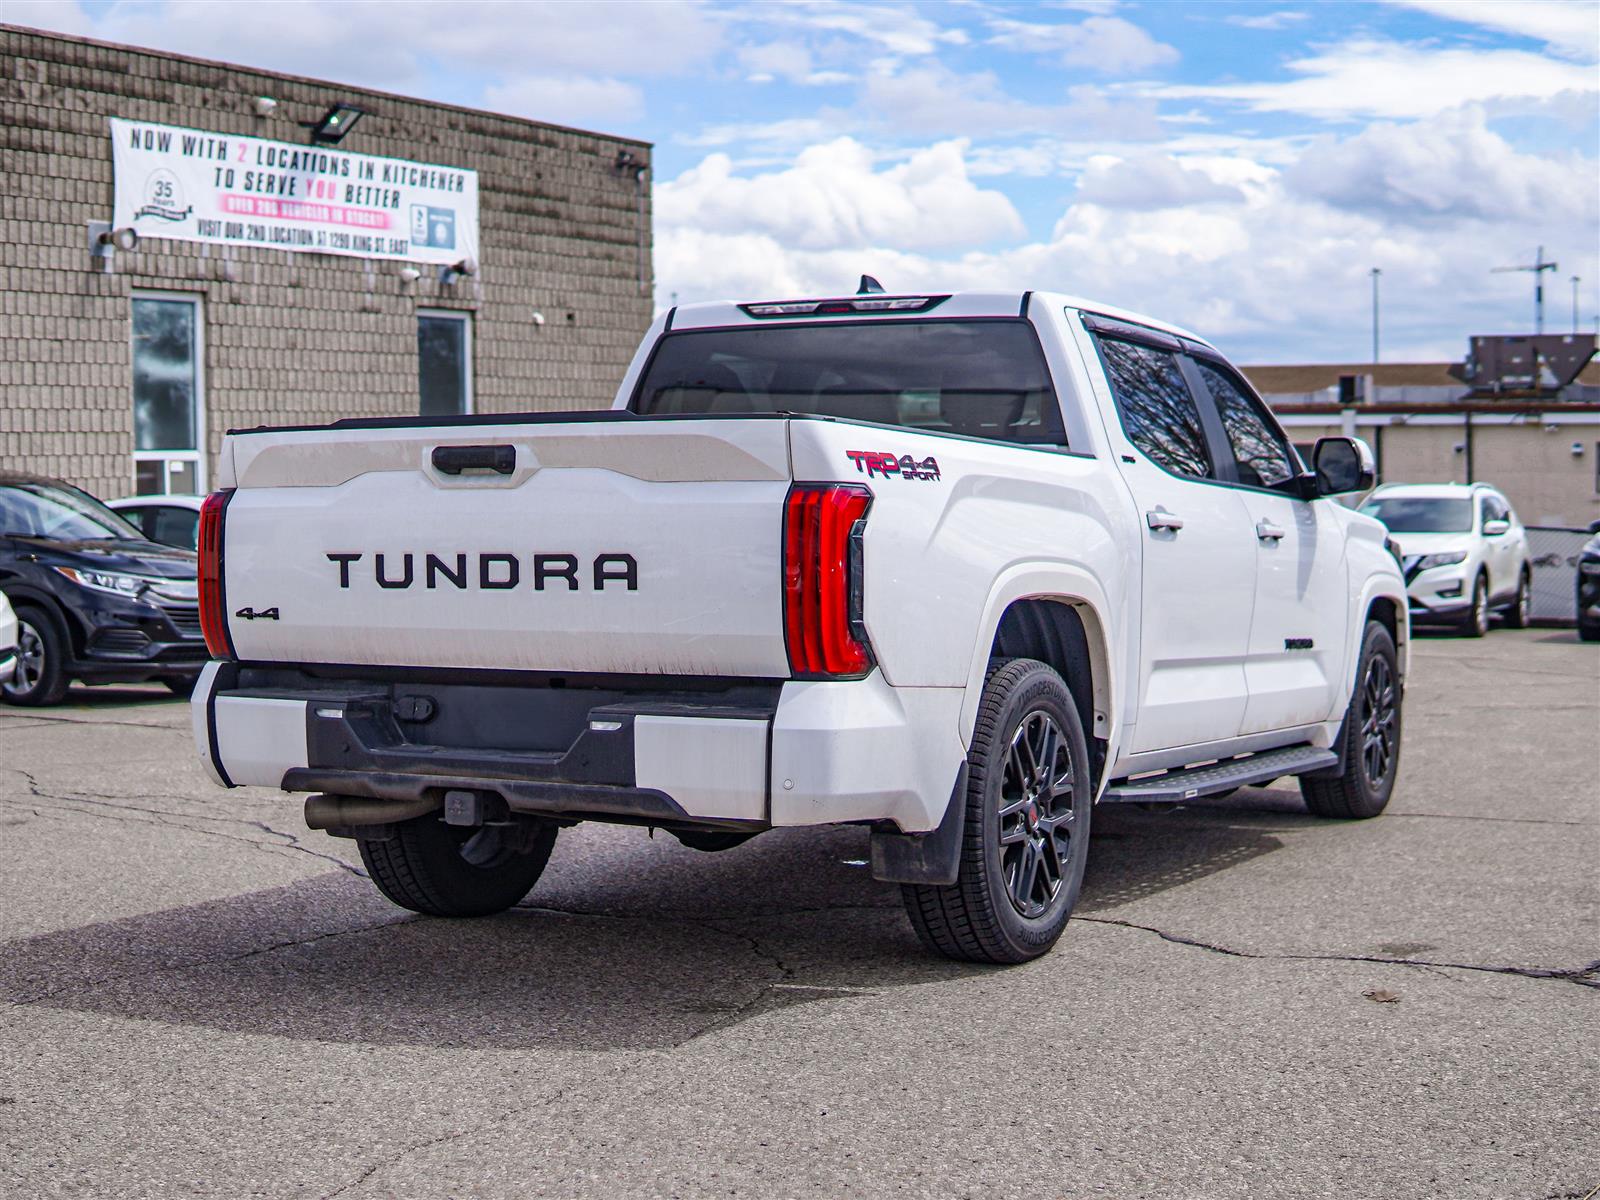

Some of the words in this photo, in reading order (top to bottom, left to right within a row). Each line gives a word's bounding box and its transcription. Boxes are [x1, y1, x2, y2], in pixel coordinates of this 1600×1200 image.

[130, 128, 172, 153] NOW
[182, 134, 227, 161] WITH
[237, 143, 248, 162] 2
[257, 145, 350, 177] LOCATIONS
[358, 160, 375, 180] IN
[383, 161, 465, 193] KITCHENER
[155, 180, 172, 198] 35
[214, 167, 235, 189] TO
[244, 171, 296, 196] SERVE
[306, 178, 336, 200] YOU
[345, 184, 400, 209] BETTER
[198, 219, 221, 237] VISIT
[225, 221, 243, 239] OUR
[247, 223, 266, 241] 2ND
[268, 226, 313, 246] LOCATION
[353, 235, 371, 252] KING
[389, 238, 408, 256] EAST
[845, 450, 900, 479] TRD
[902, 470, 940, 482] SPORT
[326, 553, 637, 591] TUNDRA
